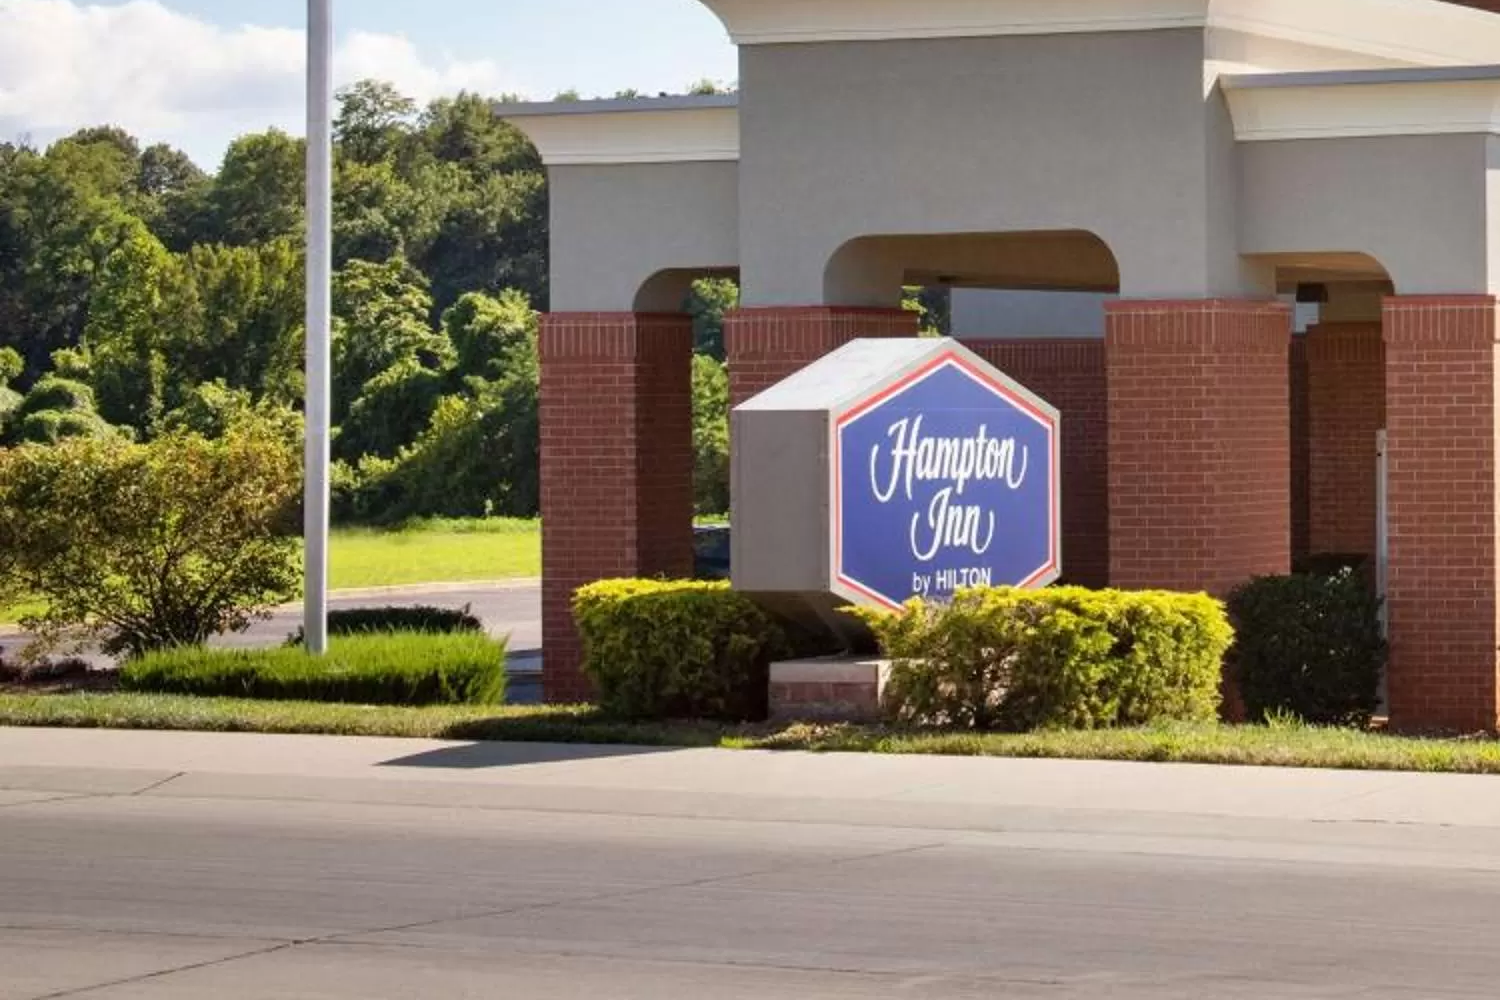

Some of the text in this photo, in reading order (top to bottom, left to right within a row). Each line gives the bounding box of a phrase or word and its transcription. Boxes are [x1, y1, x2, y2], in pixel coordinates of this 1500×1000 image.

[870, 413, 1028, 502] Hampton
[910, 486, 995, 561] Inn
[912, 567, 993, 597] by HILTON
